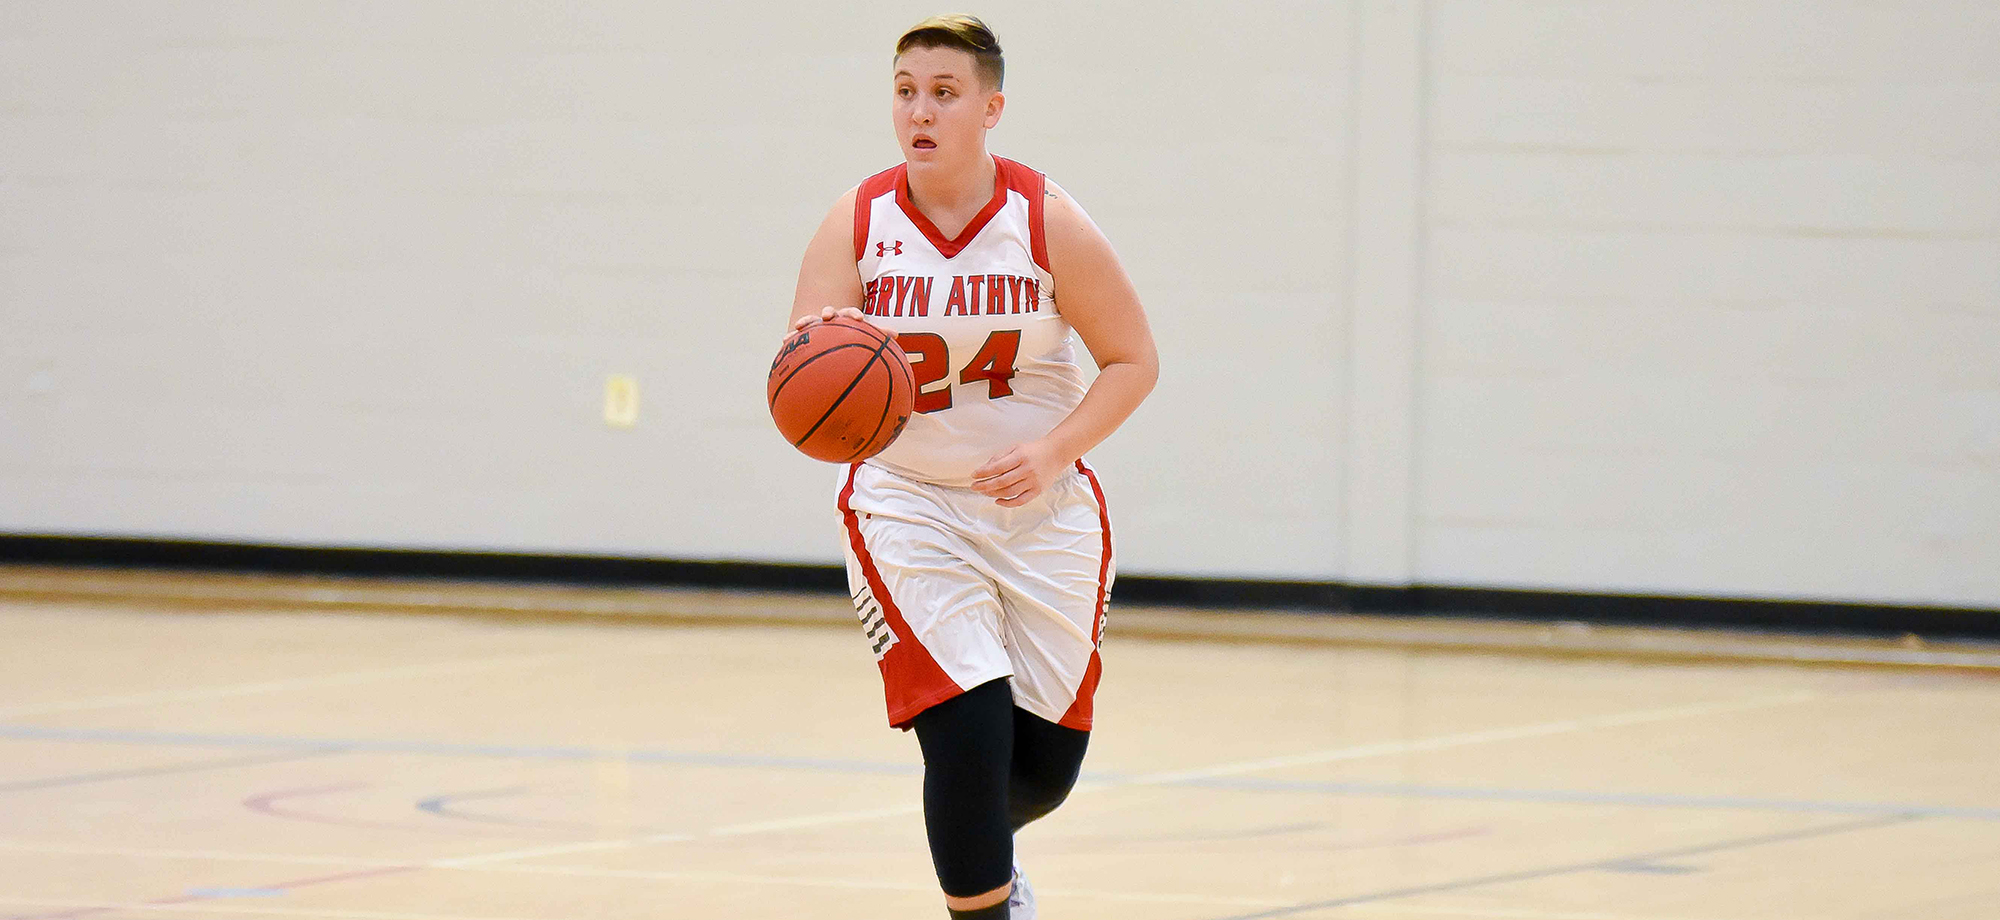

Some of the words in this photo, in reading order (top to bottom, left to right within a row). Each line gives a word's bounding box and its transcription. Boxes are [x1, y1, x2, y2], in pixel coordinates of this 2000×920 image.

[864, 276, 934, 317] BRYN
[944, 274, 1040, 317] ATHYN
[898, 329, 1022, 414] 24
